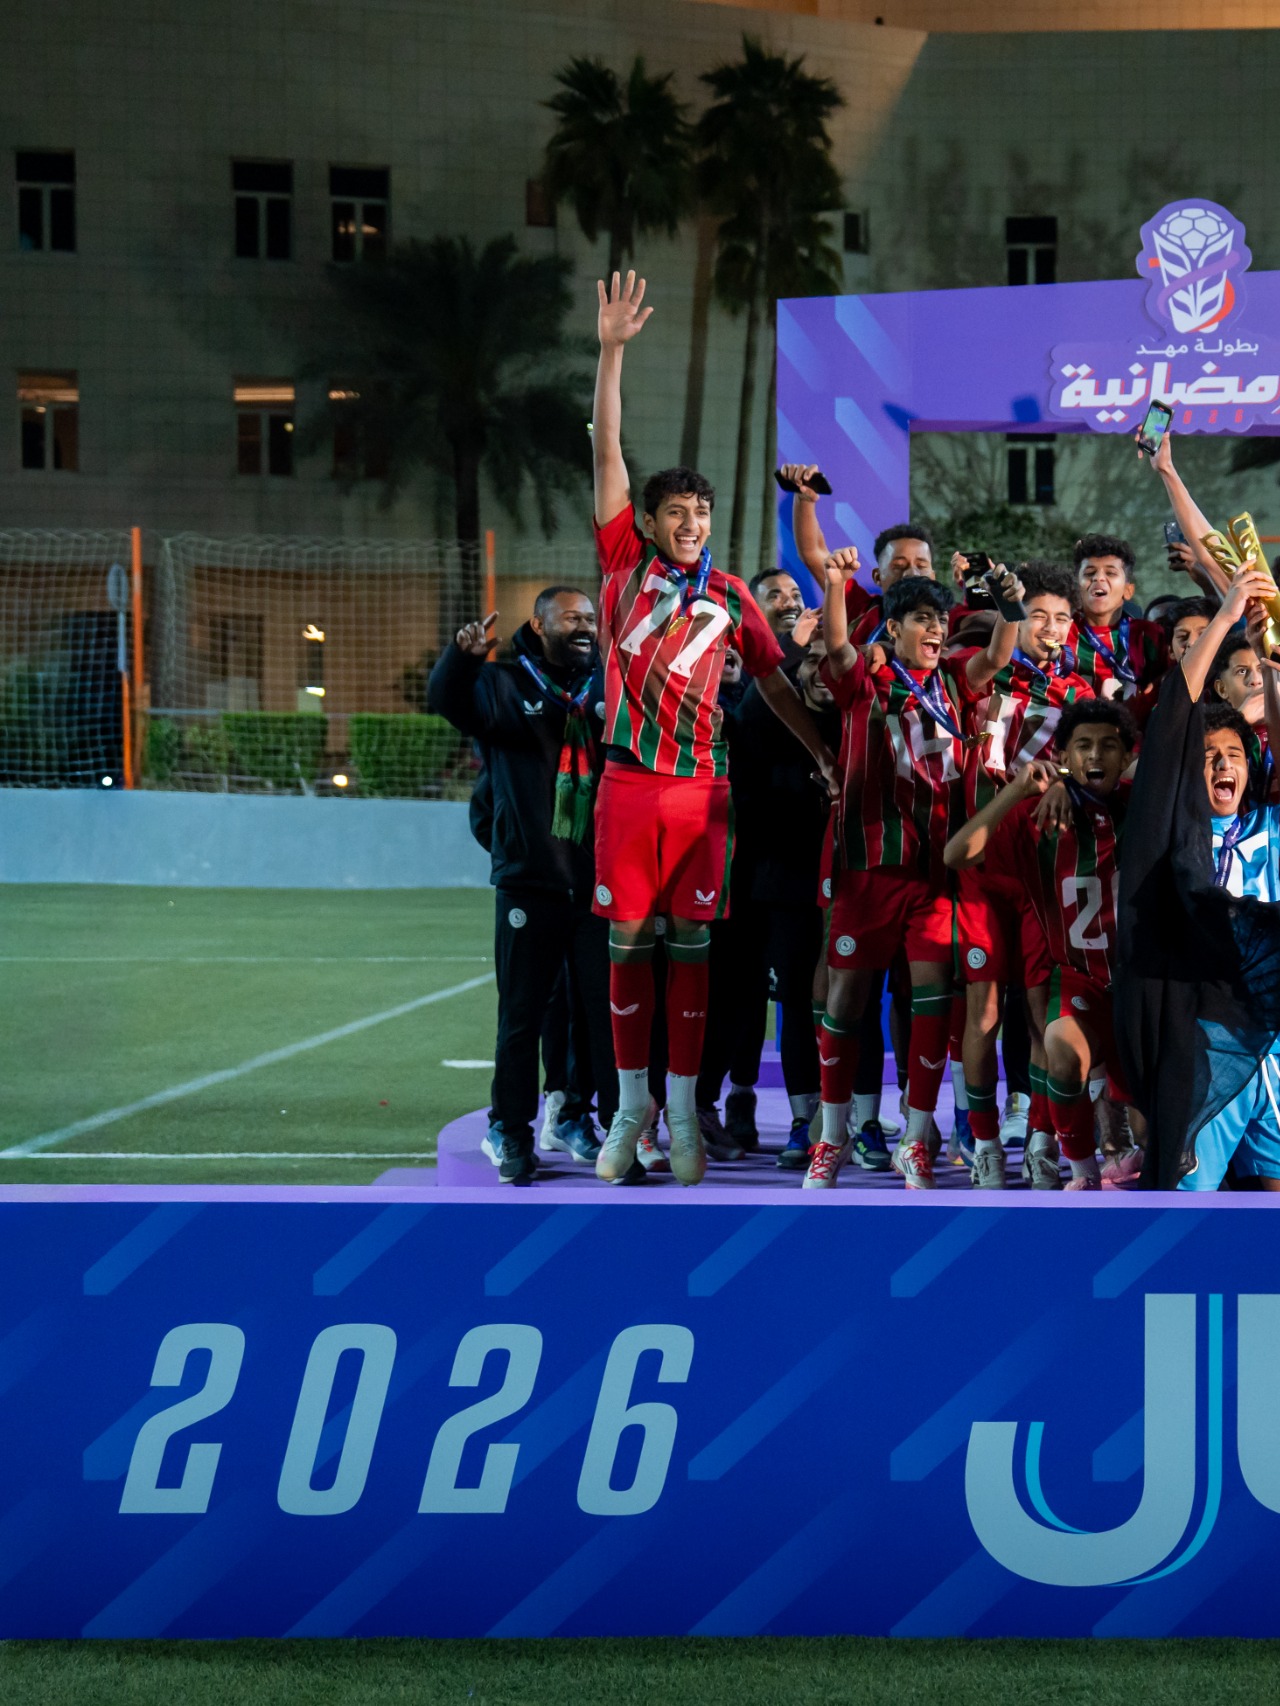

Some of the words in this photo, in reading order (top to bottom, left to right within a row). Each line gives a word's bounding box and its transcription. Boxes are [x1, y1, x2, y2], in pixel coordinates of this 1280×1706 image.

[1136, 343, 1189, 358] مهد
[1194, 338, 1259, 357] بطولة
[1182, 409, 1244, 425] 026
[620, 574, 732, 679] 77
[886, 698, 961, 785] 14
[1061, 870, 1121, 950] 2
[118, 1323, 695, 1516] 2026
